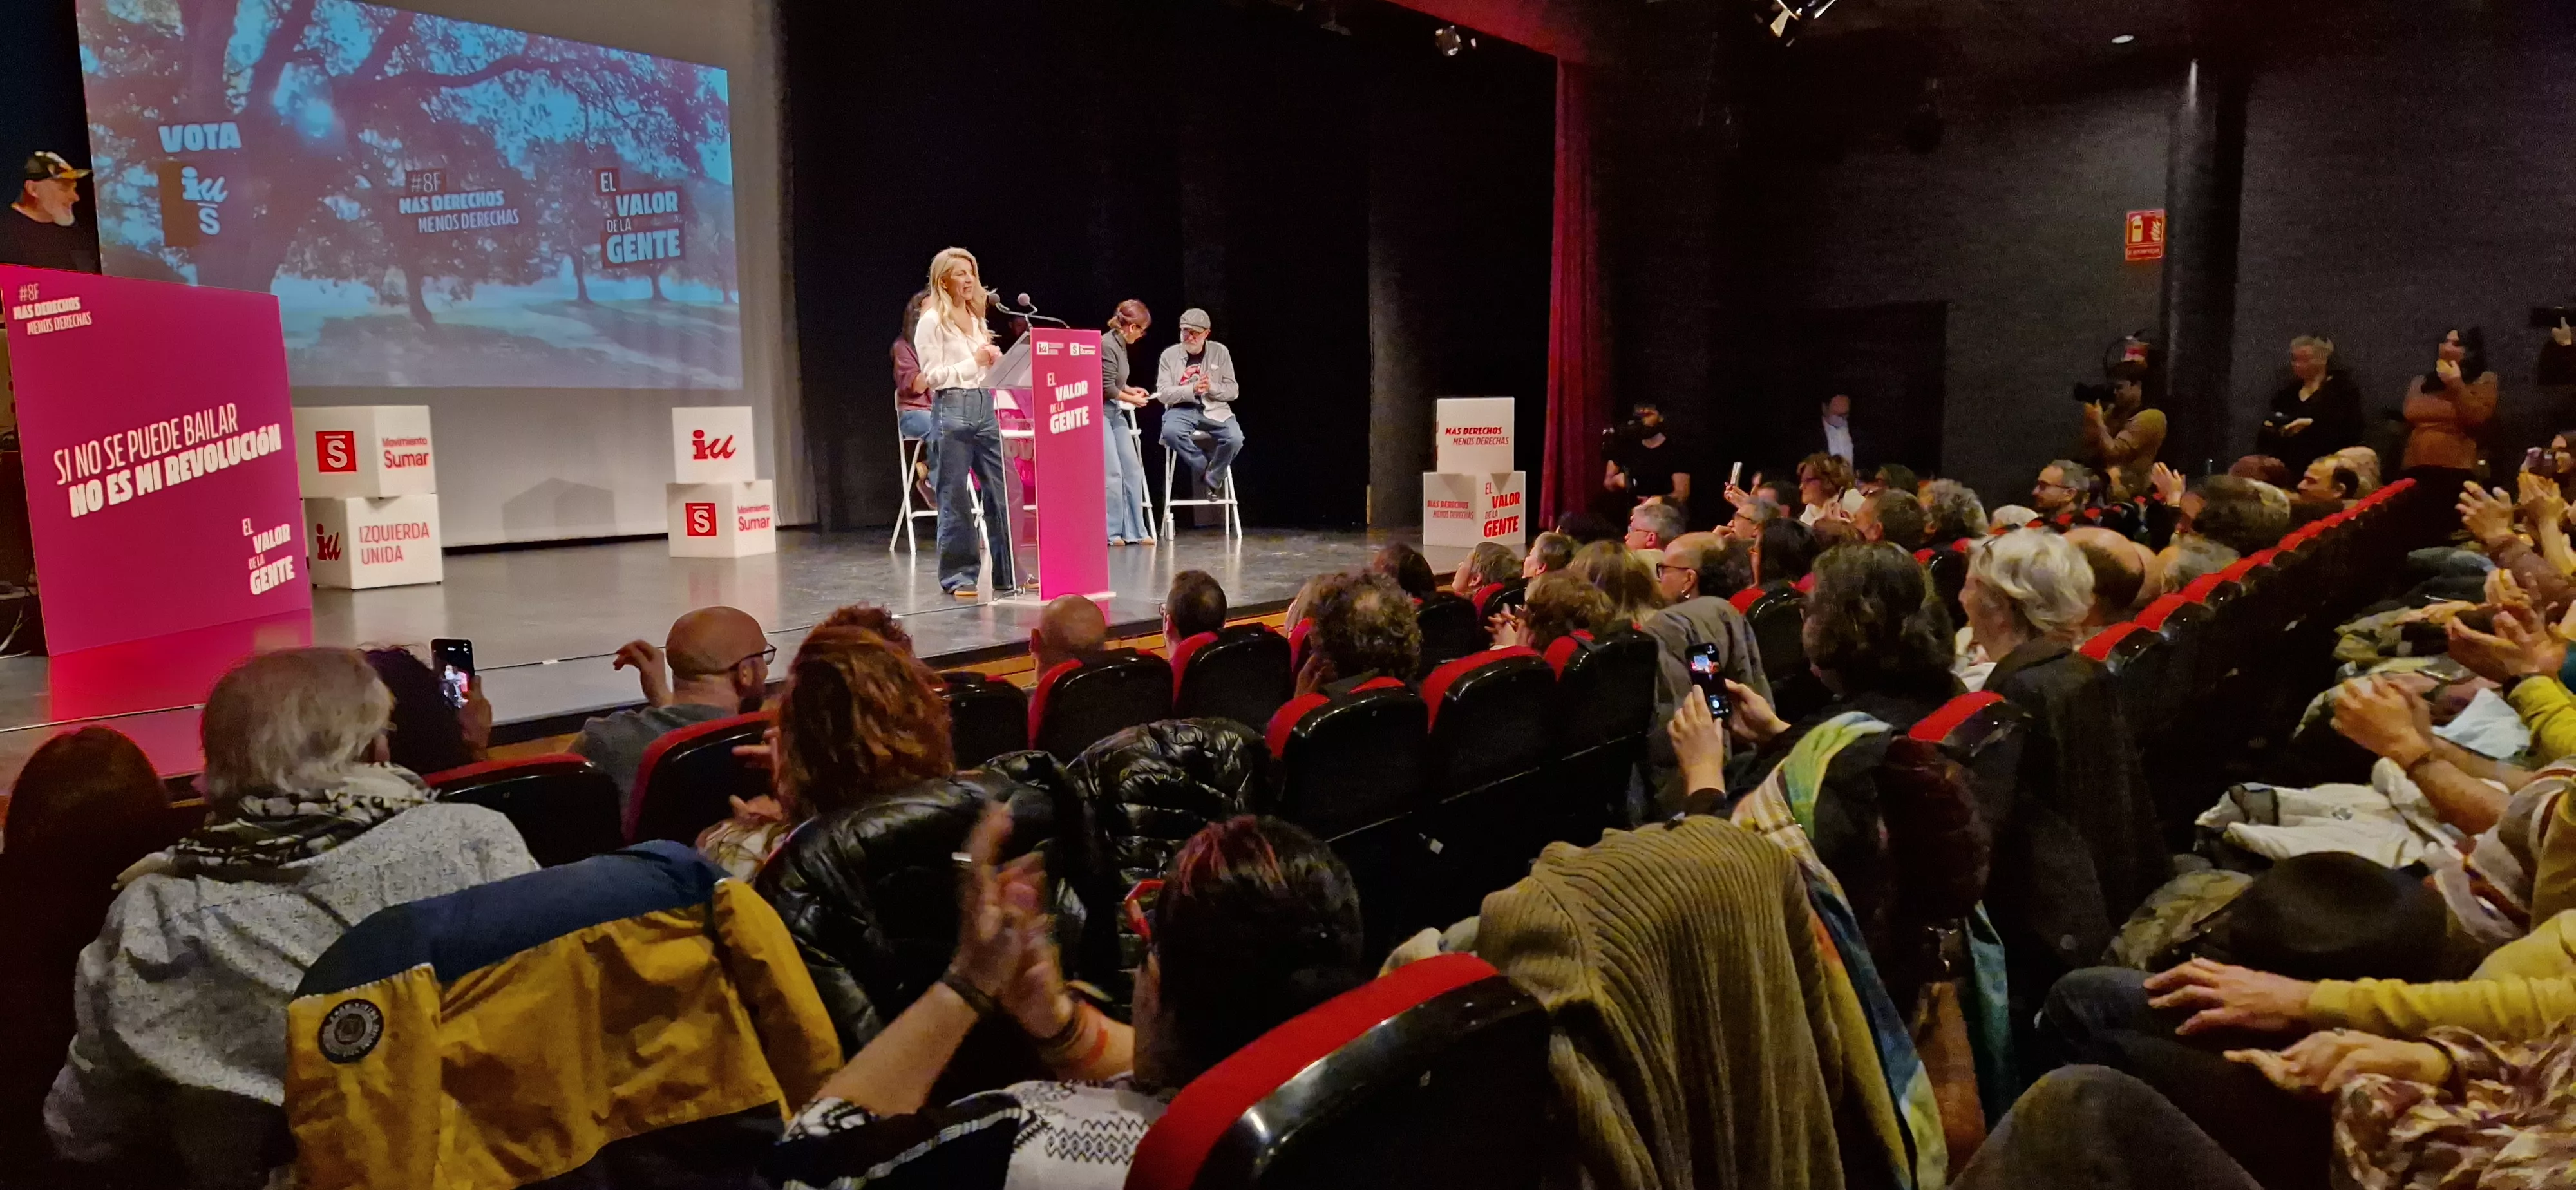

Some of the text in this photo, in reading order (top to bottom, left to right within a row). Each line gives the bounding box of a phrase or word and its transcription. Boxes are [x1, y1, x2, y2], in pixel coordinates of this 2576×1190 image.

[158, 122, 242, 153] VOTA
[181, 166, 228, 203] iu
[411, 172, 441, 193] #8F
[600, 172, 616, 193] EL
[431, 189, 504, 212] DERECHOS
[615, 190, 679, 217] VALOR
[419, 208, 519, 233] MENOS DERECHAS
[607, 218, 632, 232] DE LA
[606, 228, 681, 263] GENTE
[19, 283, 39, 301] #8F
[34, 296, 81, 316] DERECHOS
[26, 311, 92, 335] MENOS DERECHAS
[1047, 372, 1057, 387] EL
[1055, 380, 1088, 402] VALOR
[1050, 401, 1065, 414] DE LA
[1050, 405, 1090, 434] GENTE
[1463, 426, 1502, 435] DERECHOS
[53, 402, 239, 485] SI NO SE PUEDE BAILAR
[382, 437, 428, 448] Movimiento
[692, 429, 736, 460] iu
[1453, 437, 1509, 446] MENOS DERECHAS
[384, 450, 430, 469] Sumar
[68, 423, 282, 518] NO ES MI REVOLUCIÓN
[1485, 482, 1493, 495] EL
[1492, 491, 1520, 509] VALOR
[738, 516, 770, 531] Sumar
[1485, 509, 1498, 519] DE LA
[242, 518, 254, 536] EL
[359, 522, 430, 543] IZQUIERDA
[1484, 515, 1519, 538] GENTE
[252, 524, 291, 554] VALOR
[316, 523, 341, 561] iu
[249, 553, 265, 570] DE LA
[361, 545, 404, 565] UNIDA
[250, 555, 296, 595] GENTE
